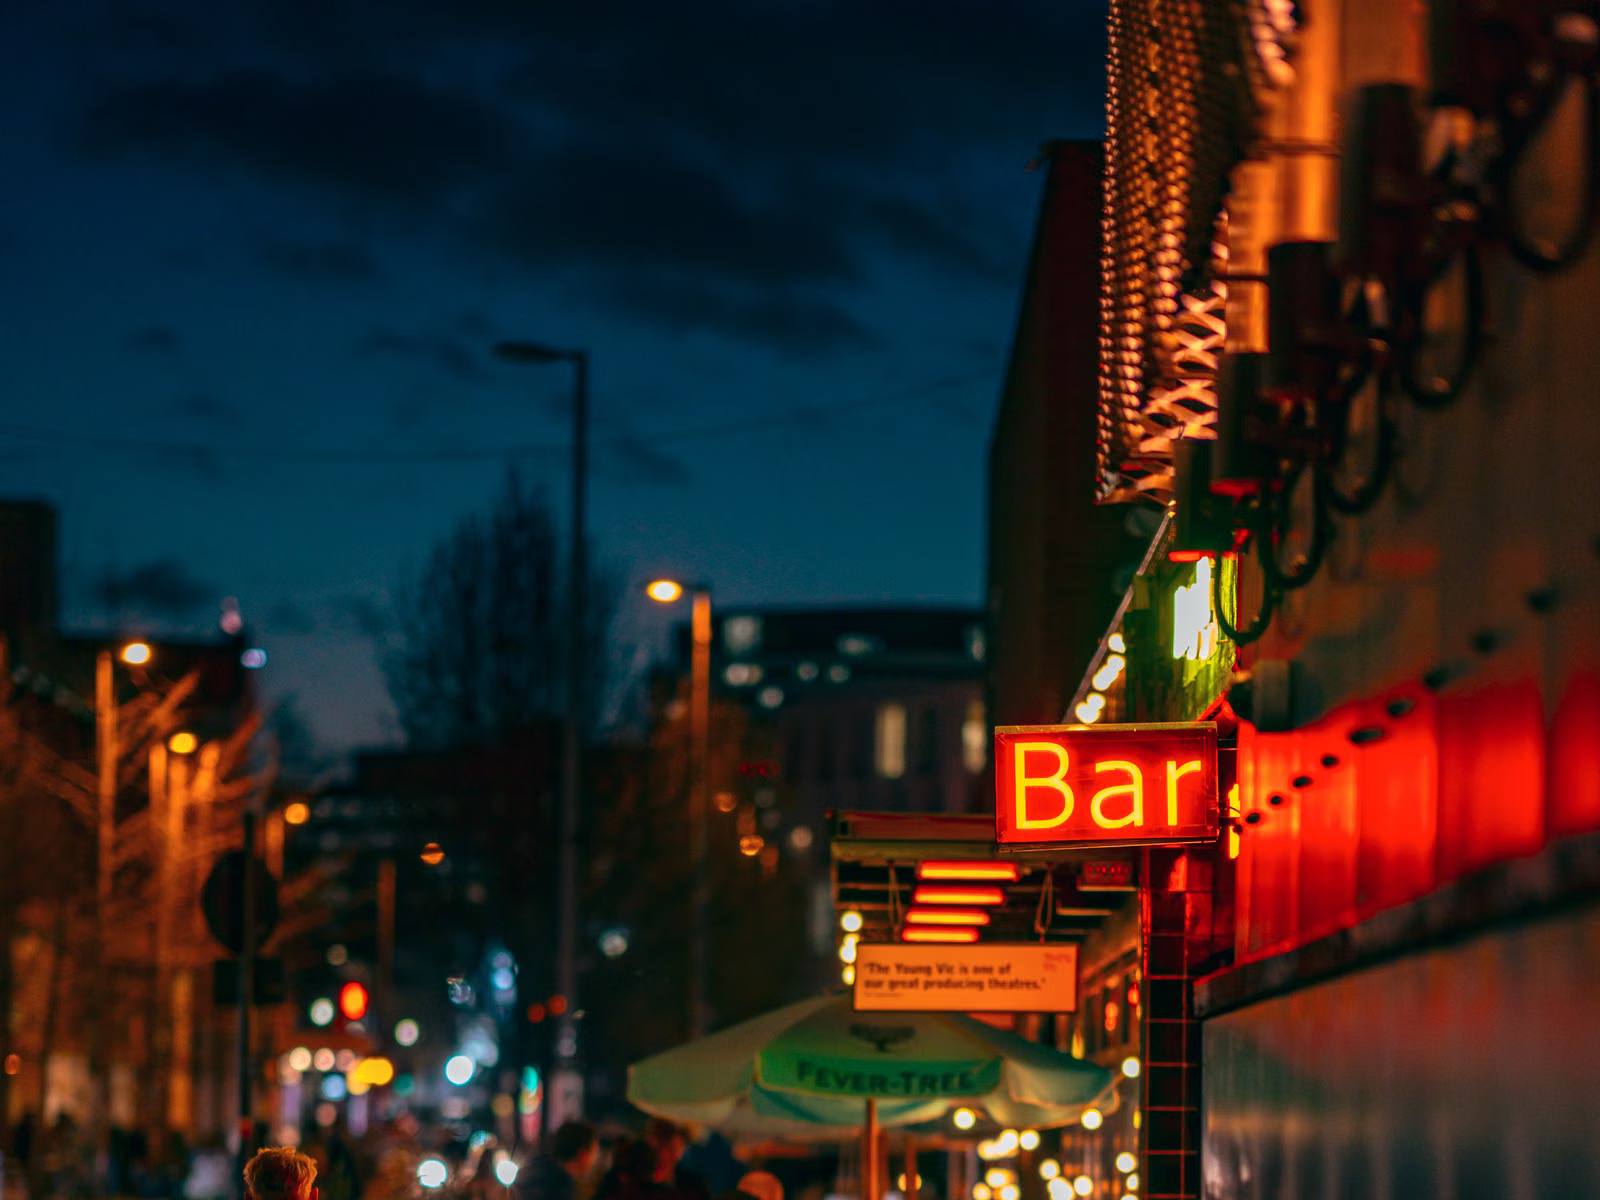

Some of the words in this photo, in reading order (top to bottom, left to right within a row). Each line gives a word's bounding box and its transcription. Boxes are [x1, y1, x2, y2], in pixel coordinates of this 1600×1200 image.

[1014, 741, 1201, 829] Bar
[895, 962, 932, 977] Young
[936, 962, 954, 975] Vic
[960, 962, 969, 975] is
[973, 965, 993, 975] one
[998, 962, 1011, 975] of
[864, 979, 883, 989] our
[888, 977, 919, 991] great
[924, 977, 985, 992] producing
[796, 1060, 974, 1095] FEVER-TREE
